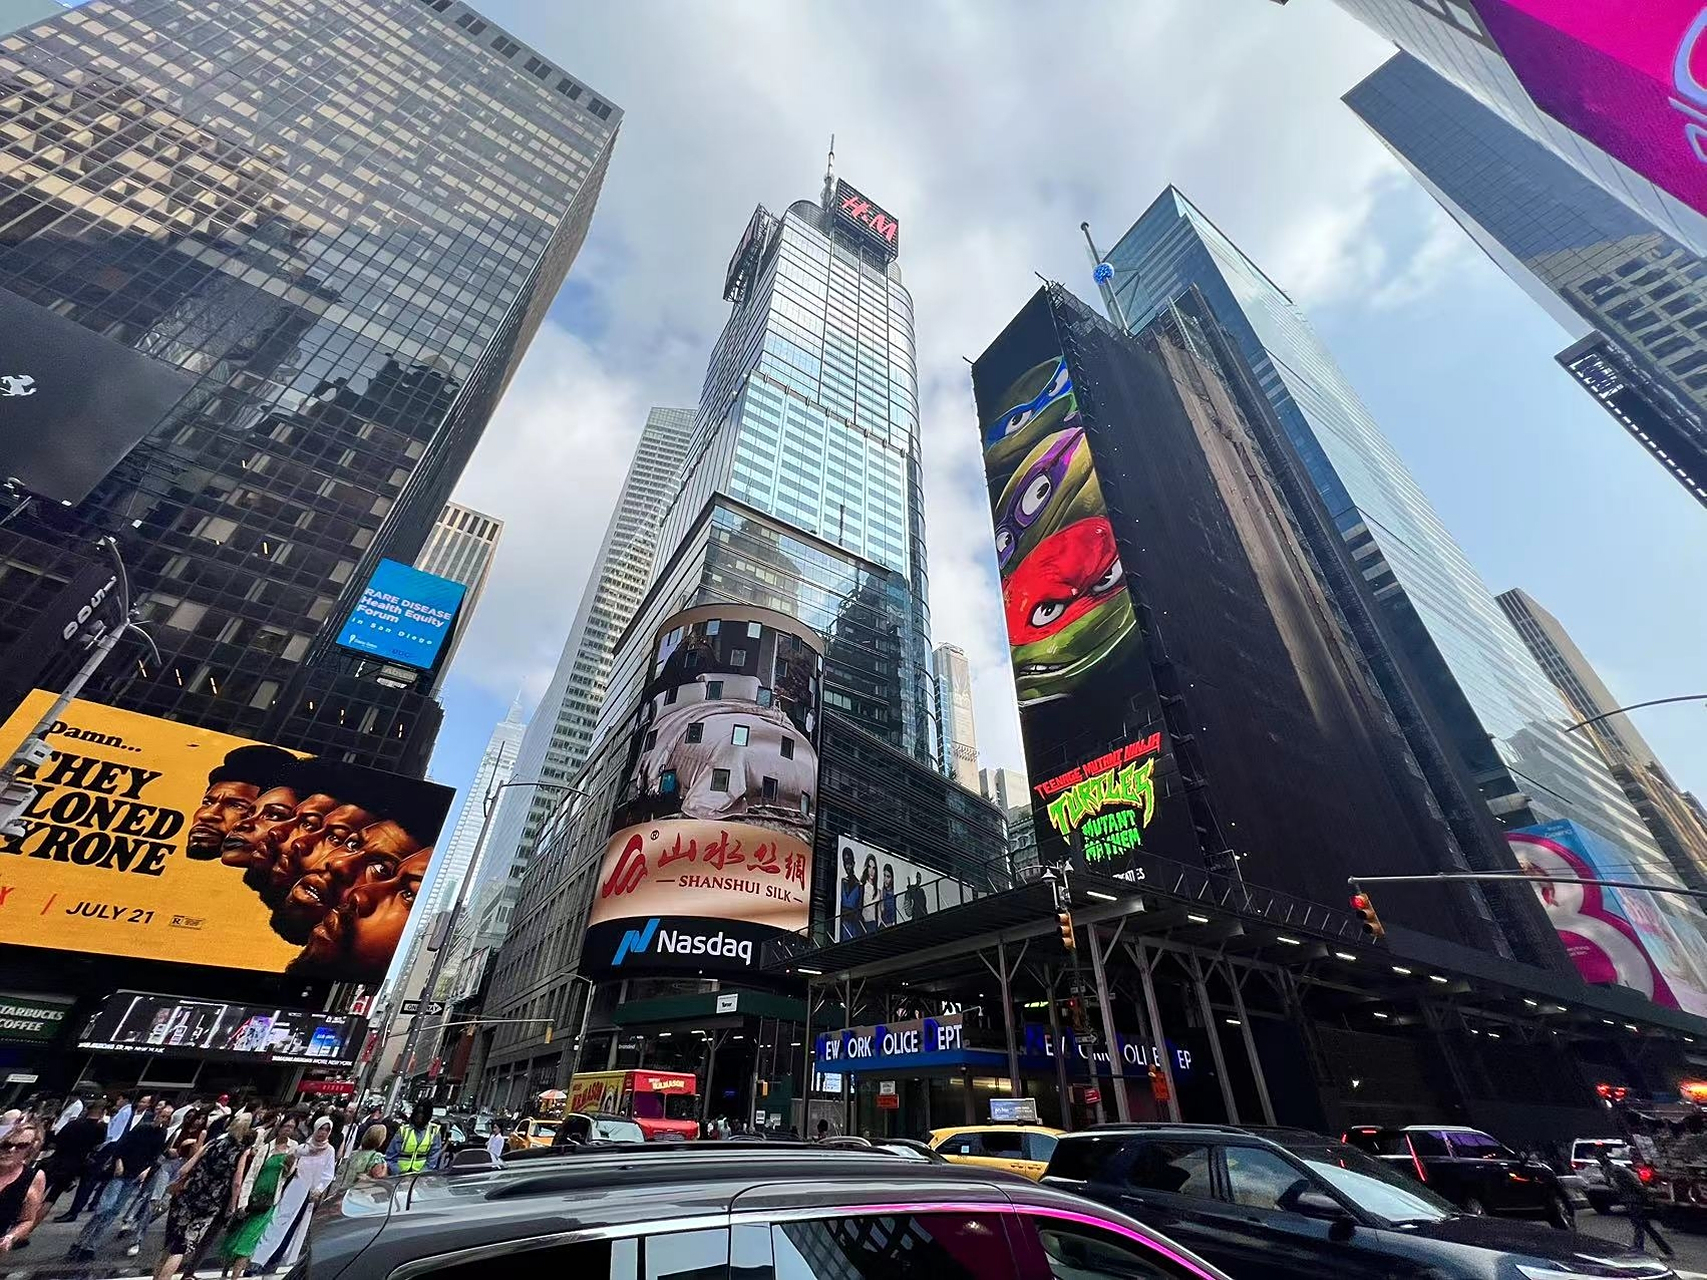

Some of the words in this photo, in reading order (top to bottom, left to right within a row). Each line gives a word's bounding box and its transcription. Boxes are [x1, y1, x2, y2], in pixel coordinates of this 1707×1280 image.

[356, 604, 400, 623] Forum
[361, 595, 402, 614] Health
[404, 609, 445, 627] Equity
[364, 588, 400, 604] RARE
[401, 599, 452, 620] DISEASE
[370, 622, 392, 633] San
[397, 630, 433, 645] Diego
[49, 720, 142, 752] Damn...
[1034, 767, 1083, 800] TEENAGE
[1082, 748, 1123, 778] MUTANT
[1123, 732, 1161, 763] NINJA
[19, 781, 185, 841] LONED
[1047, 758, 1155, 846] TURTLES
[1082, 809, 1137, 838] MUTANT
[1, 818, 177, 877] YRONE
[678, 875, 760, 895] SHANSHUI
[765, 885, 792, 903] SILK
[66, 901, 128, 920] JULY
[127, 908, 155, 924] 21
[656, 929, 753, 966] Nasdaq
[0, 1004, 65, 1021] TARBUCKS
[923, 1018, 963, 1053] DEPT
